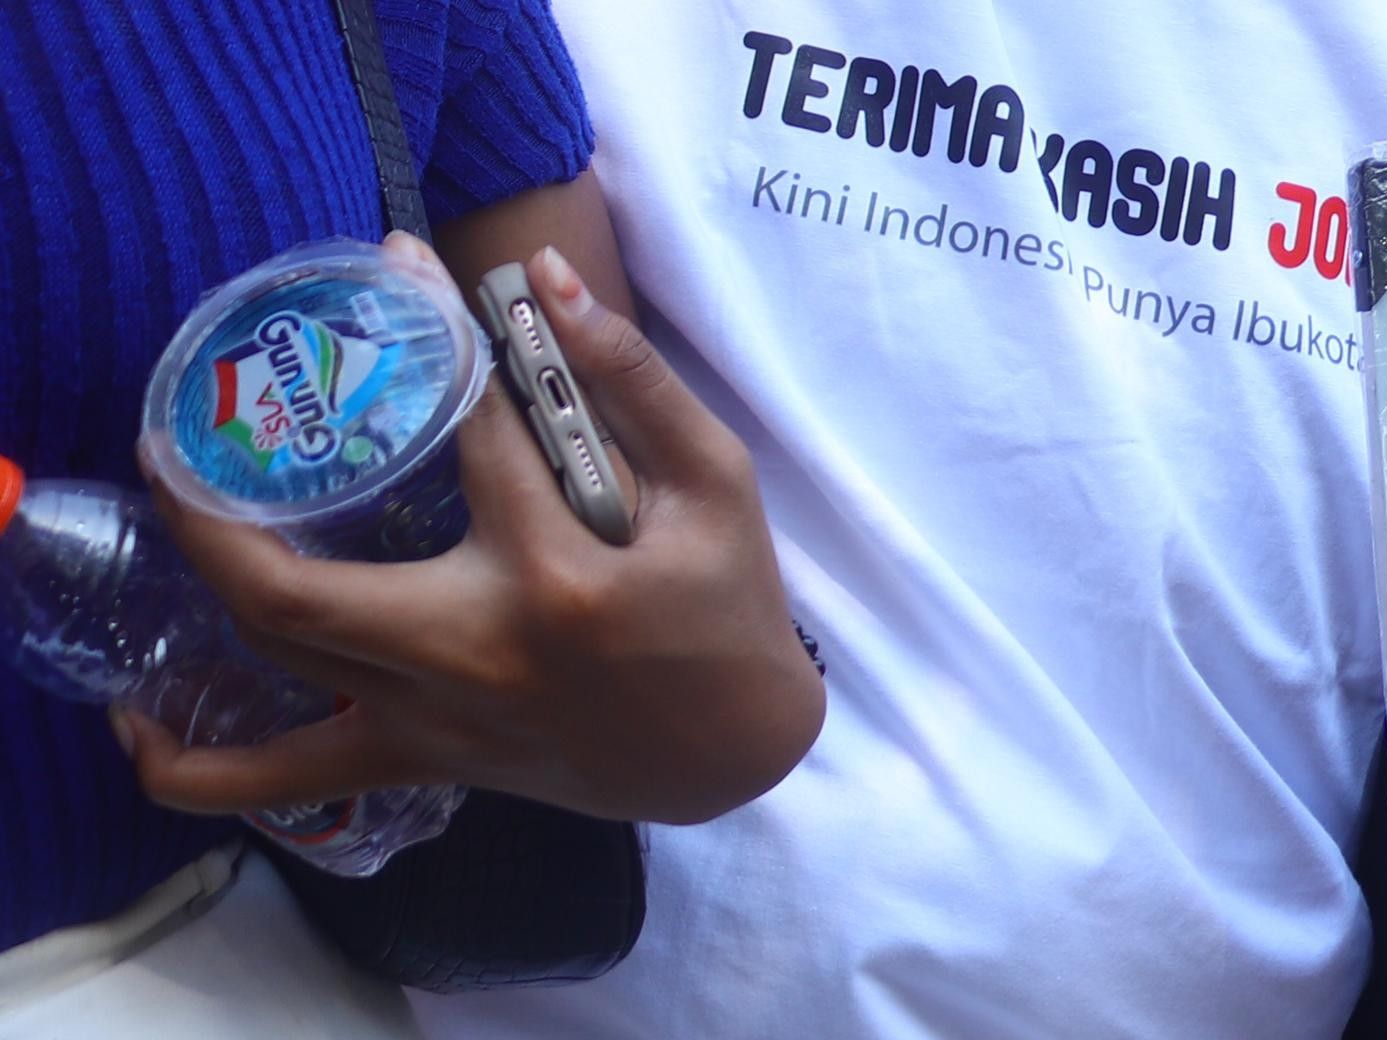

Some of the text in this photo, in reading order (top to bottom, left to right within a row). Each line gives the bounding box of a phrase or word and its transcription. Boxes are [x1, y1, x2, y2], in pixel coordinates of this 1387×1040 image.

[743, 30, 1352, 288] TERIMA KASIH JO
[752, 166, 851, 226] Kini
[1083, 265, 1216, 337] Punya
